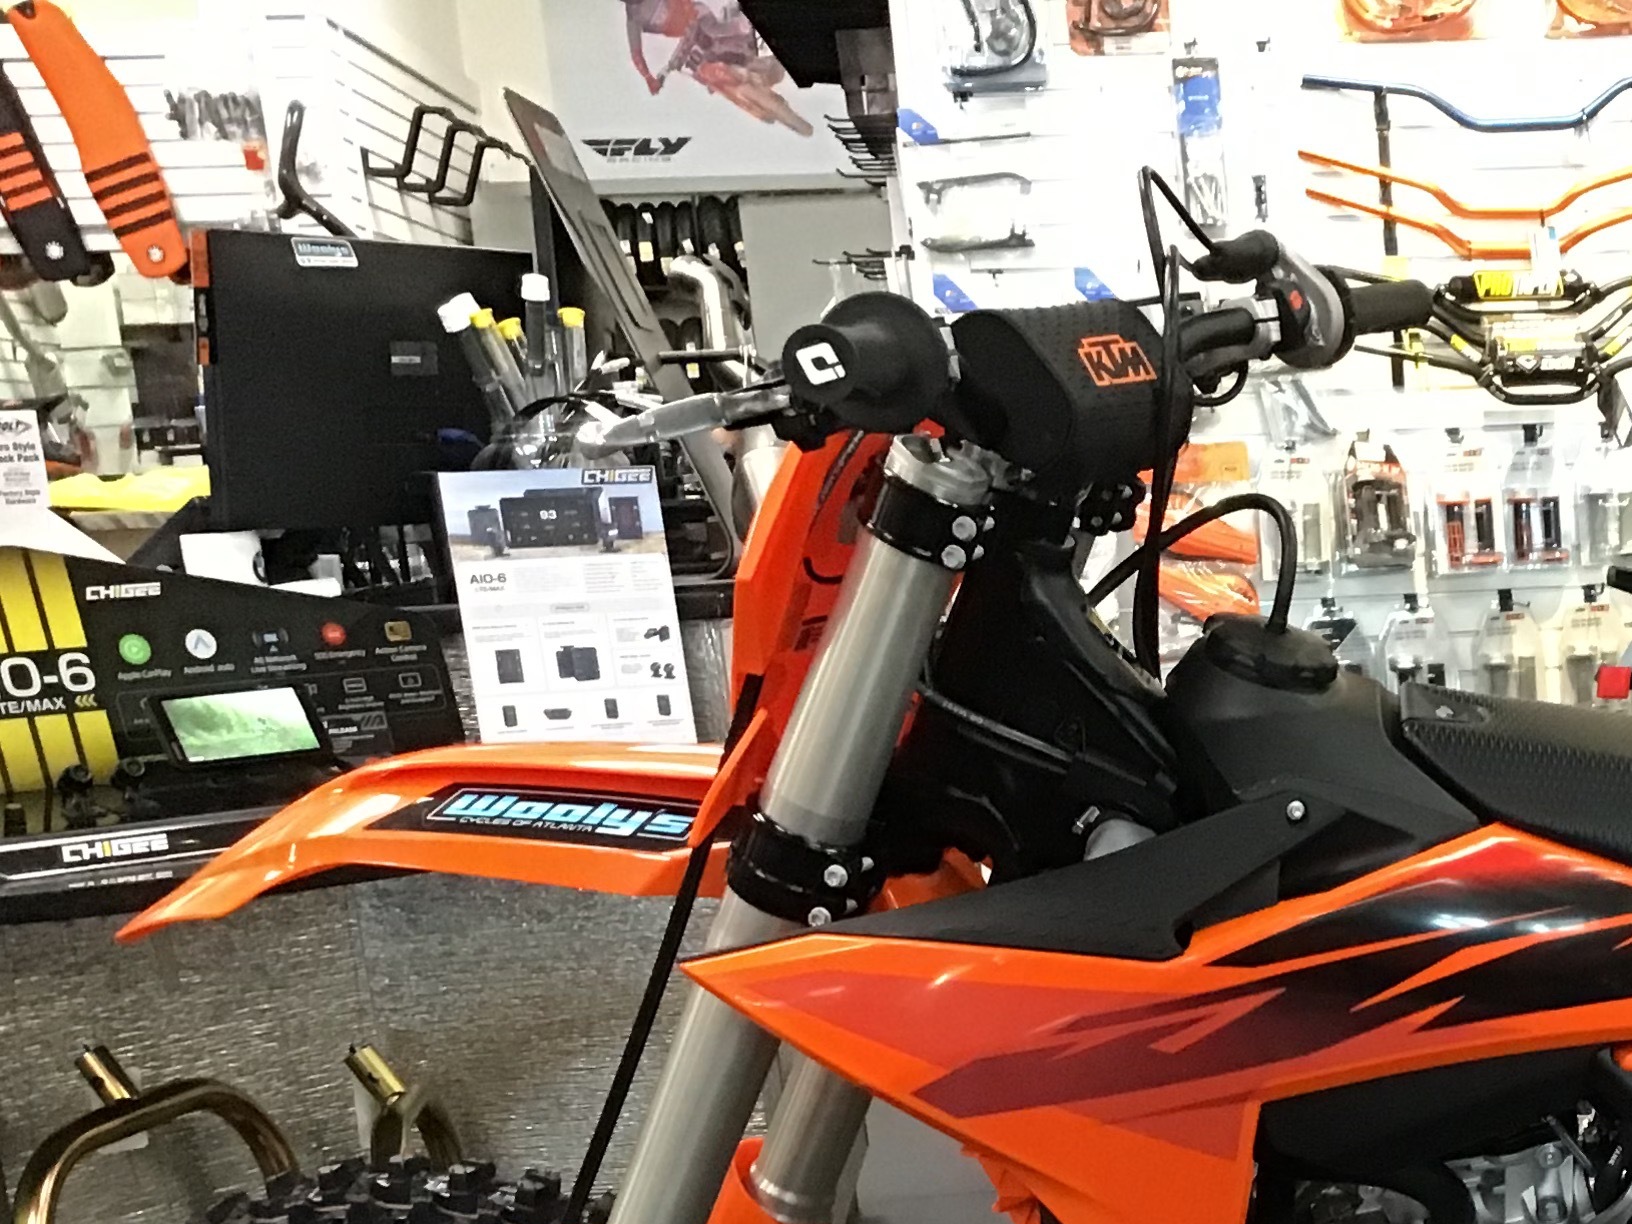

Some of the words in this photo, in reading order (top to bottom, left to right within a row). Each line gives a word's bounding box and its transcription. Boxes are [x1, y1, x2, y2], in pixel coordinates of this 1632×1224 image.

[580, 136, 692, 157] FLY
[1079, 335, 1156, 385] KTM
[583, 468, 653, 485] CHIGEE
[85, 581, 161, 601] CHIGEE
[442, 793, 697, 837] Wooly's
[458, 816, 510, 827] CYCLES
[512, 818, 533, 828] OF
[532, 820, 593, 833] ATLANTA
[61, 833, 170, 863] CHIGEE
